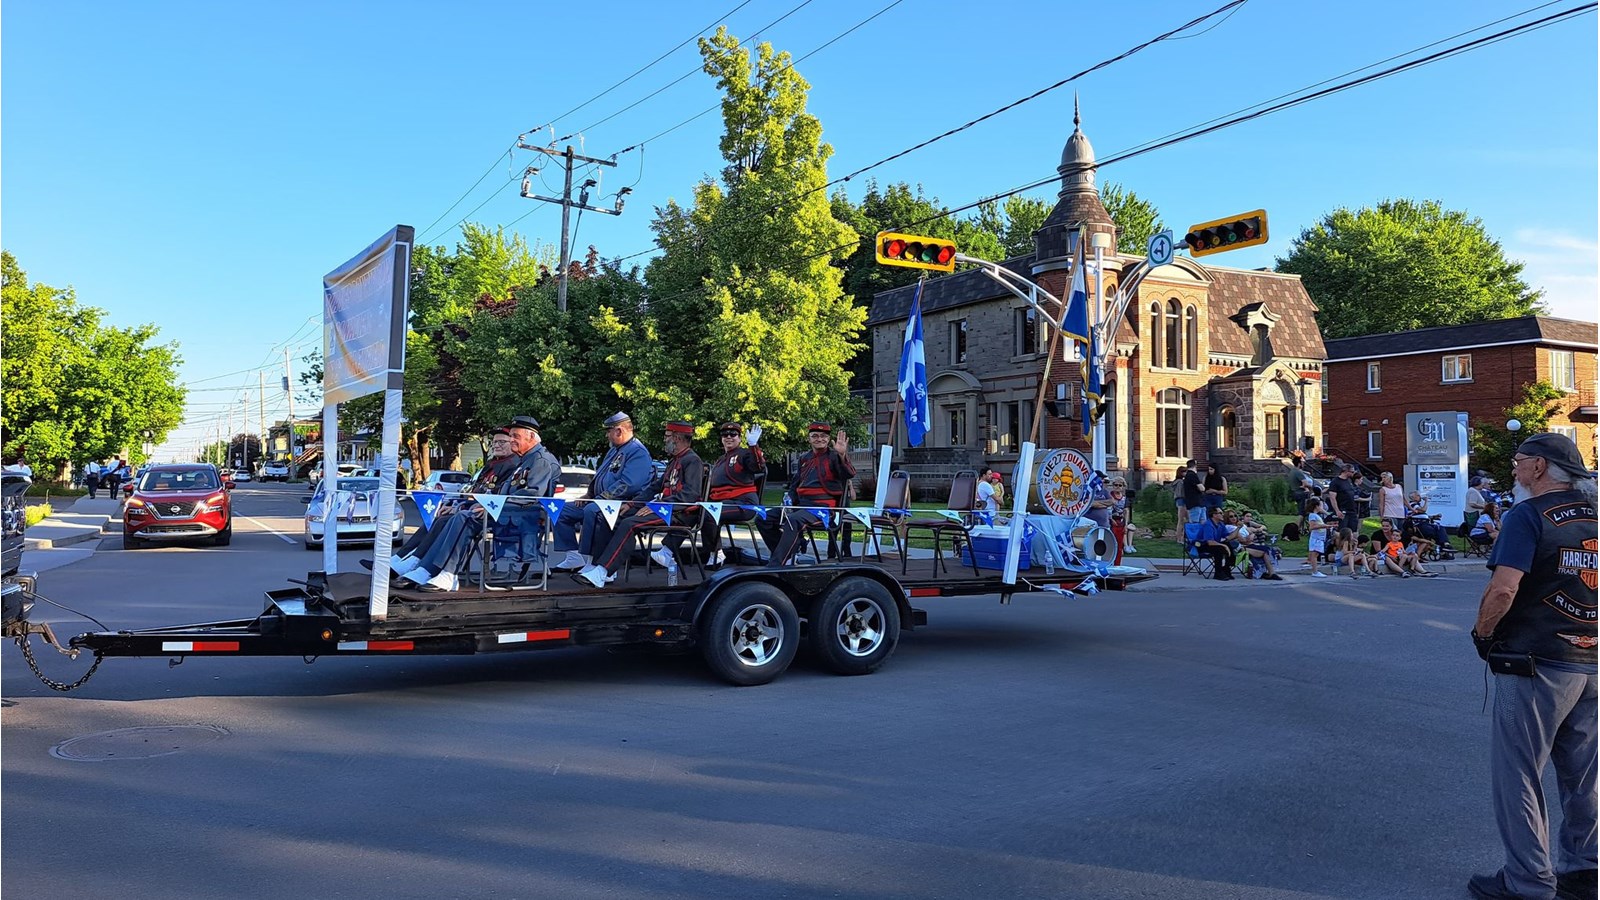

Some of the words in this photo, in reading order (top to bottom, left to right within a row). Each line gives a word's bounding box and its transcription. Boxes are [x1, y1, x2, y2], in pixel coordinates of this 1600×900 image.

[1052, 453, 1062, 466] 27
[1553, 509, 1577, 521] LIVE
[1580, 507, 1593, 515] TO
[1557, 567, 1579, 576] TRADE
[1555, 595, 1581, 616] RIDE
[1585, 610, 1597, 619] TO
